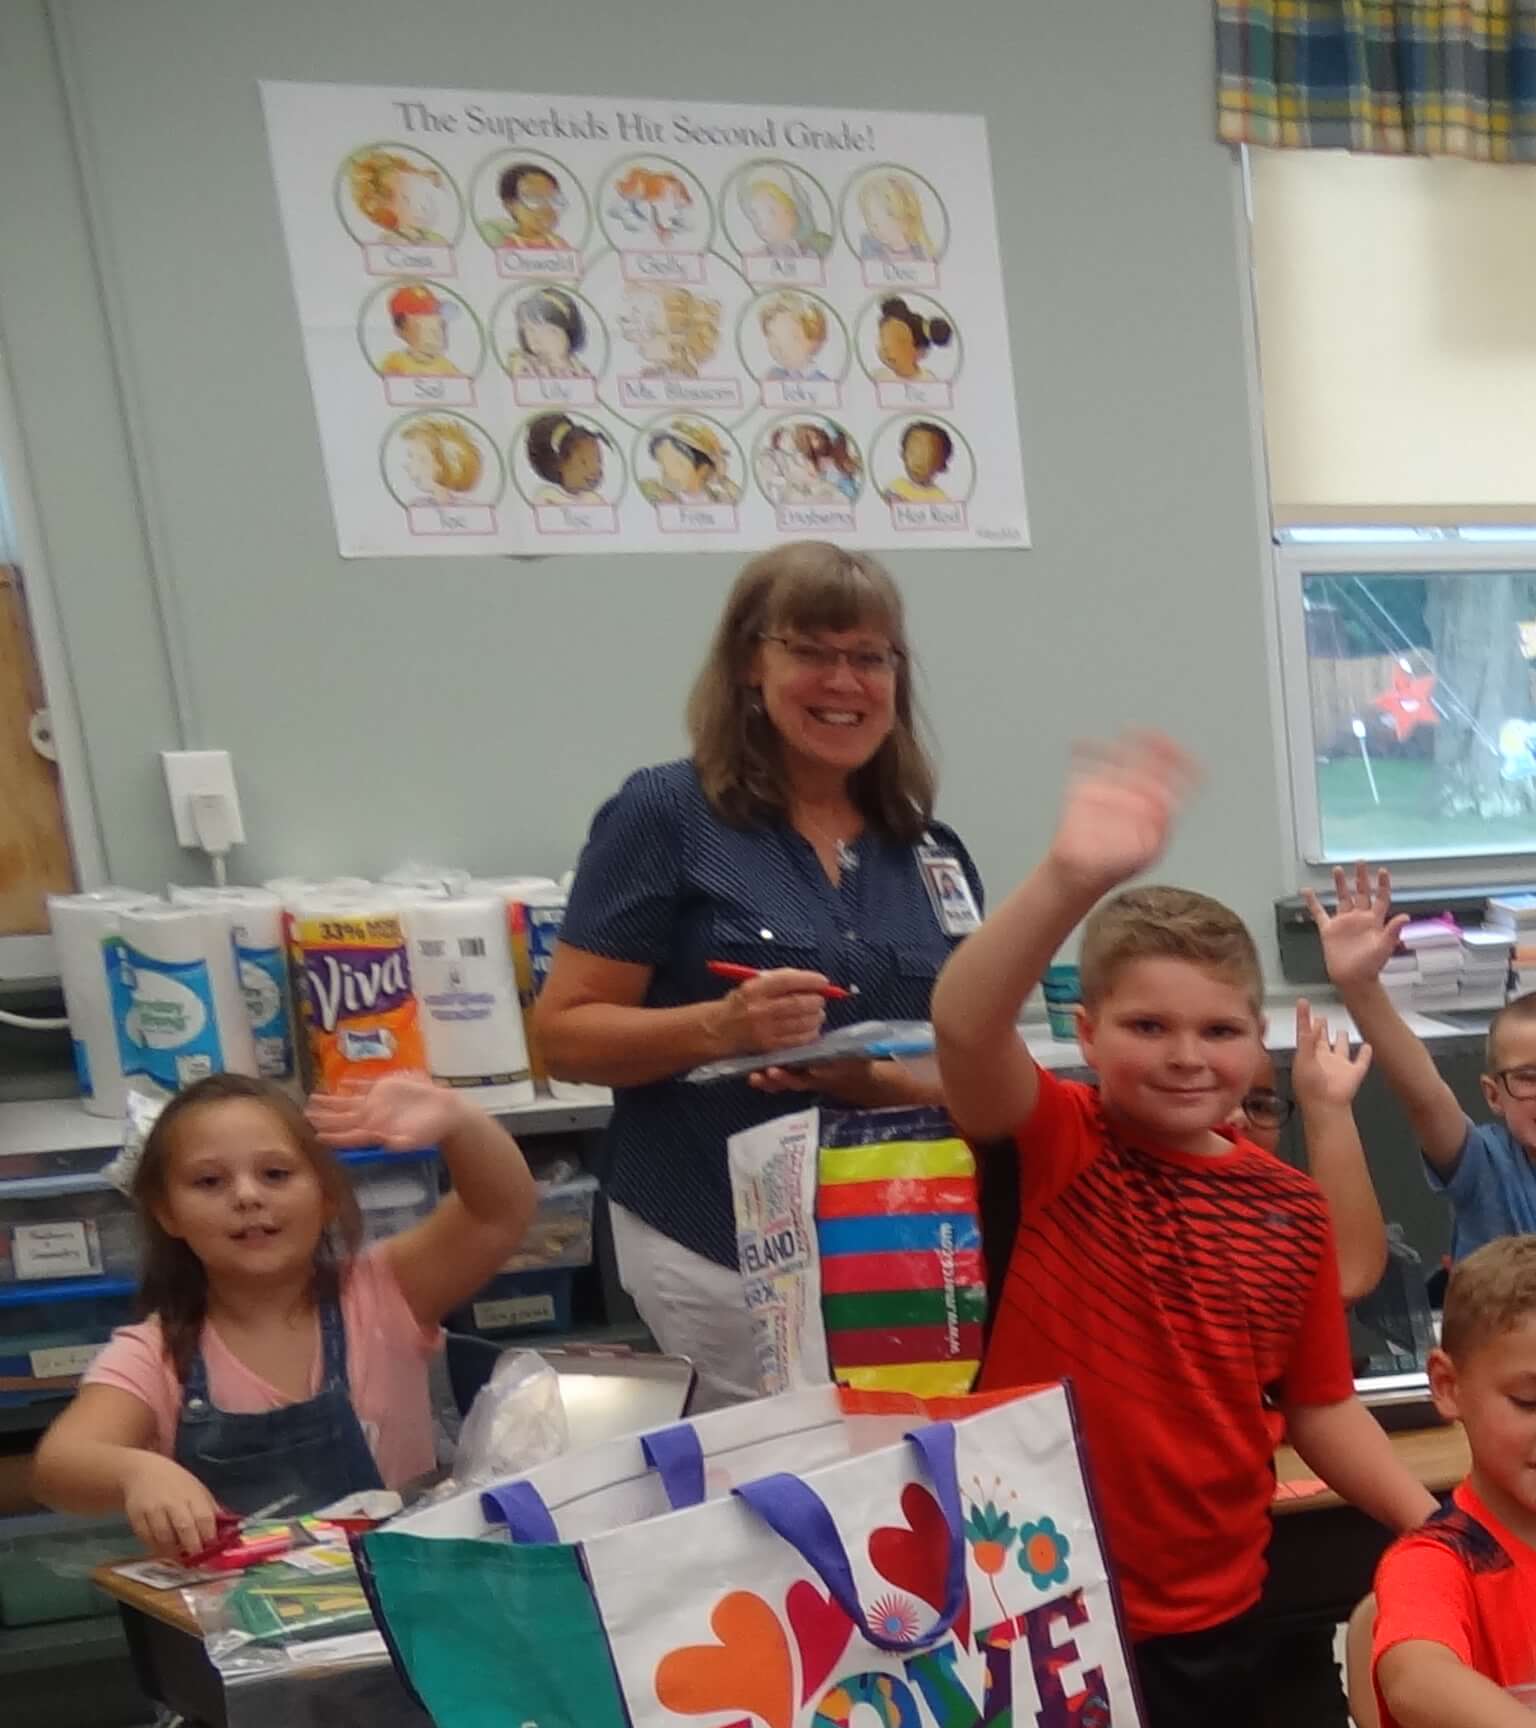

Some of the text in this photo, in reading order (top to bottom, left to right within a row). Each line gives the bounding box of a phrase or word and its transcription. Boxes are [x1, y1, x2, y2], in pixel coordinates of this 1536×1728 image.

[391, 101, 876, 152] The Superkids Hit Second Grade!
[306, 951, 410, 1034] Viva
